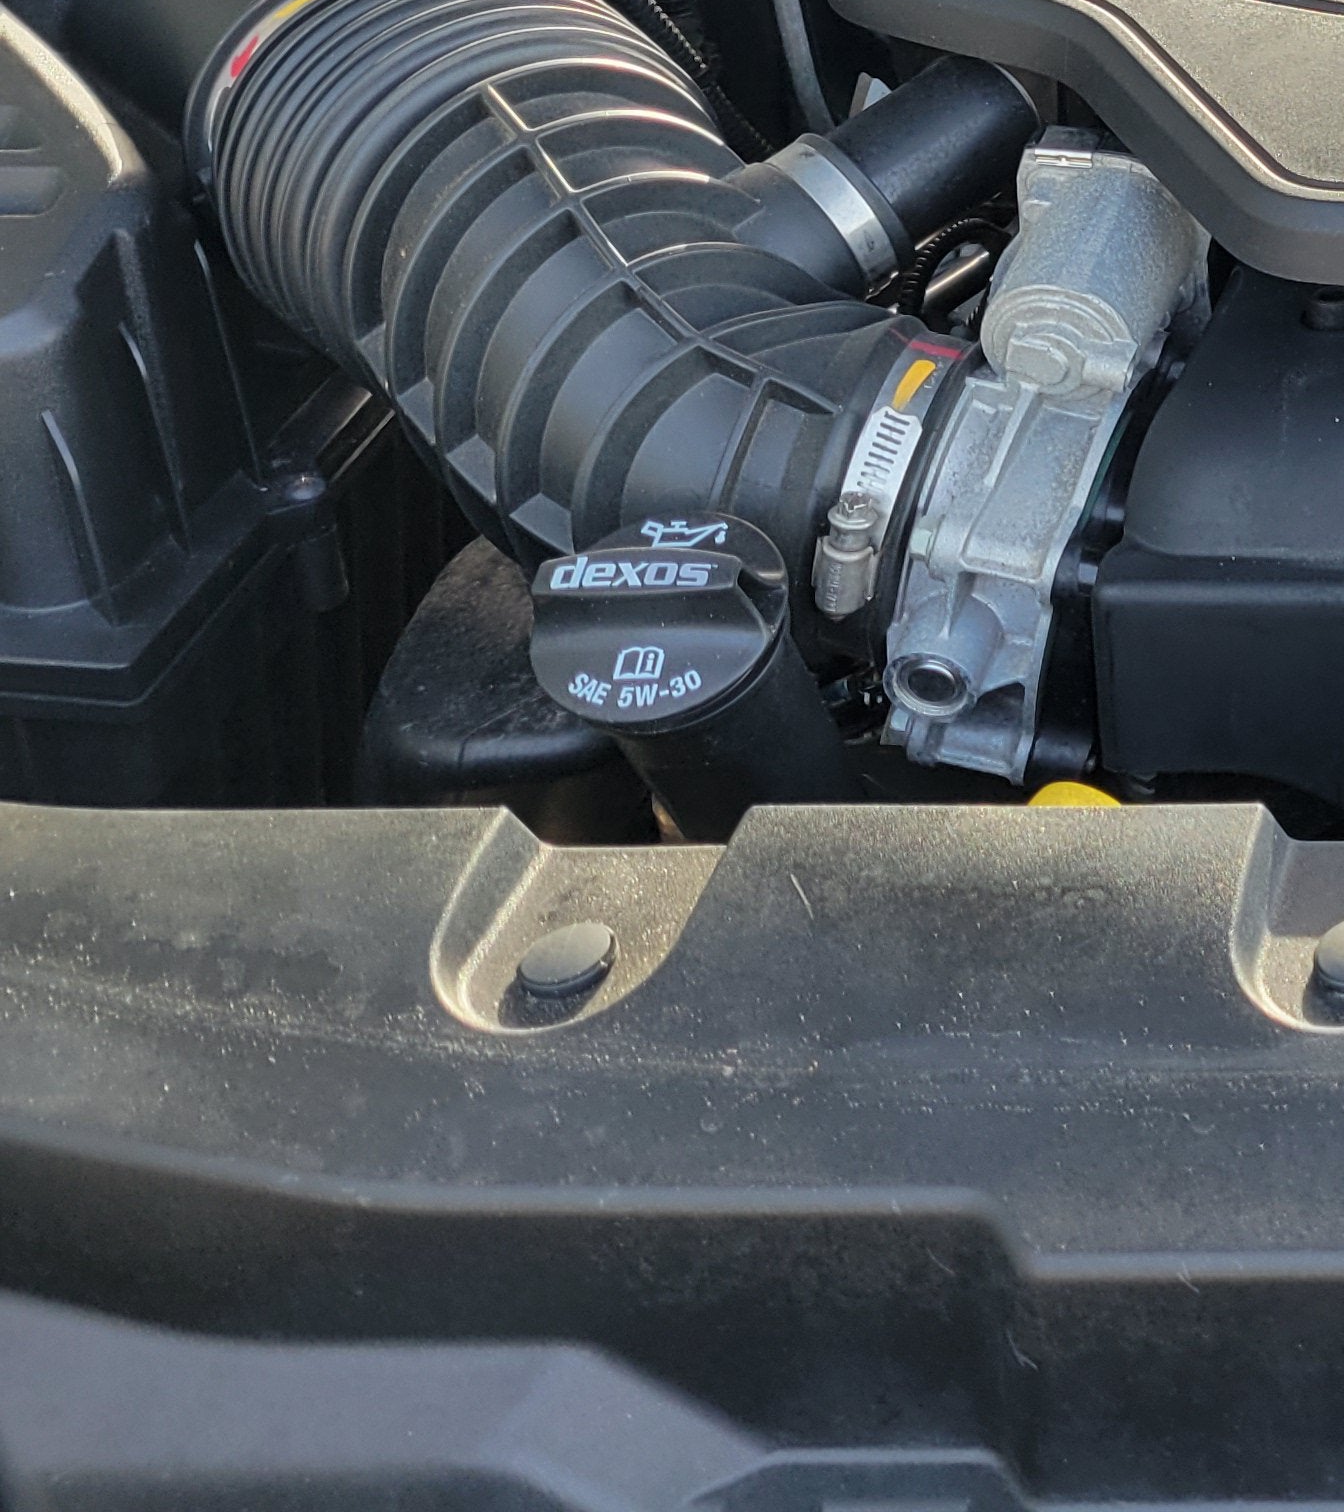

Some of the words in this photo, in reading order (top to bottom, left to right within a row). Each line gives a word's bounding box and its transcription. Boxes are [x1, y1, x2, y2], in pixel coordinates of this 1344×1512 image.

[550, 557, 713, 589] dexos
[568, 673, 612, 707] SAE
[617, 670, 702, 708] 5W-30
